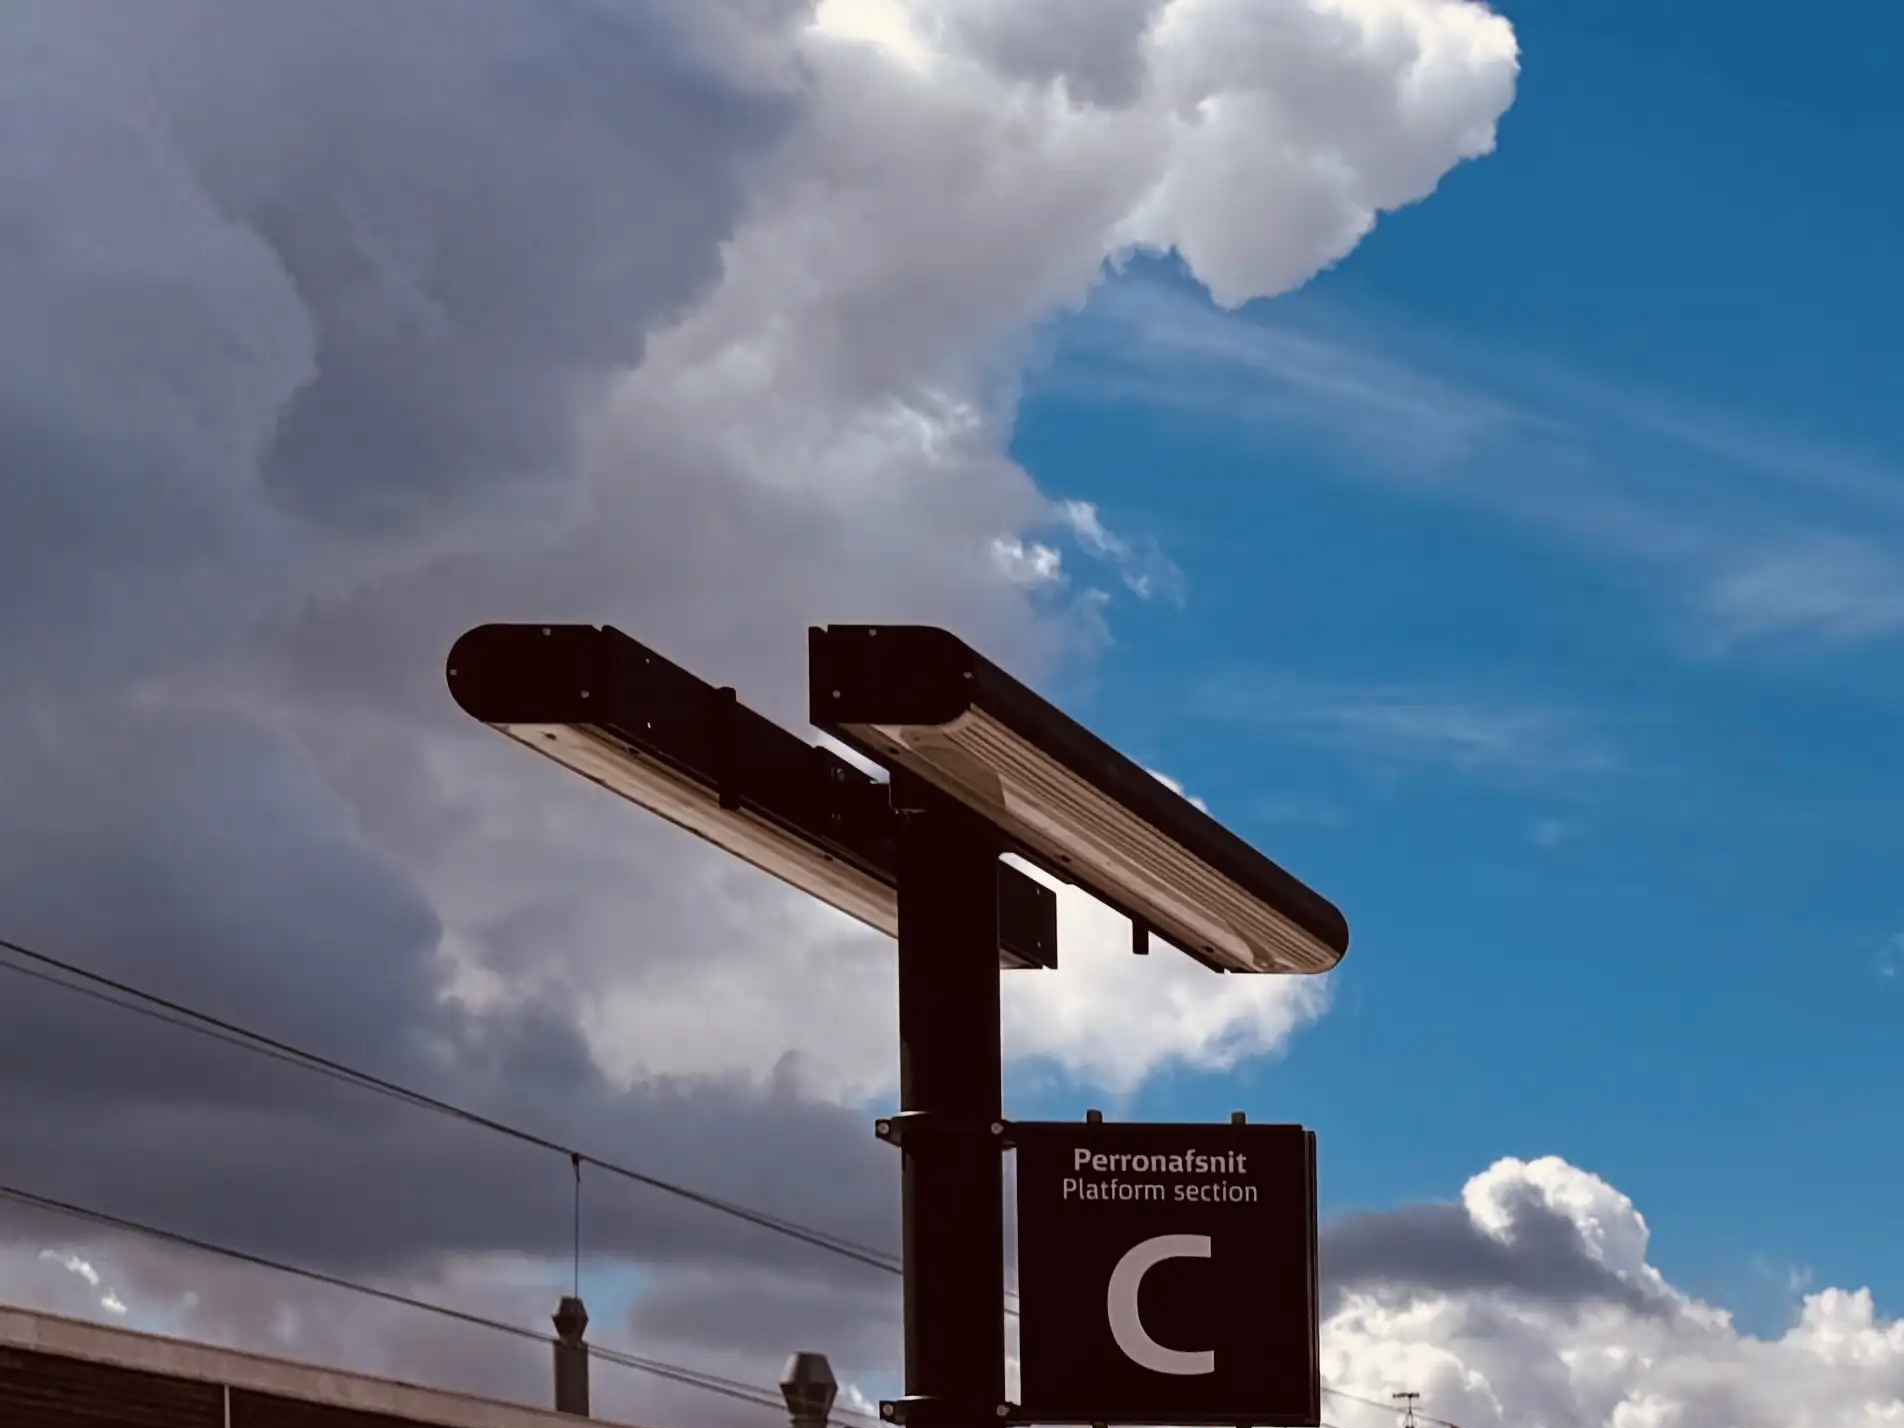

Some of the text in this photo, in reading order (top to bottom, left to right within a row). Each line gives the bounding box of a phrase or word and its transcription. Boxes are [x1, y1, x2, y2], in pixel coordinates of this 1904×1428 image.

[1073, 1148, 1248, 1174] Perronafsnit
[1063, 1178, 1258, 1202] Platform section
[1107, 1233, 1215, 1375] C
